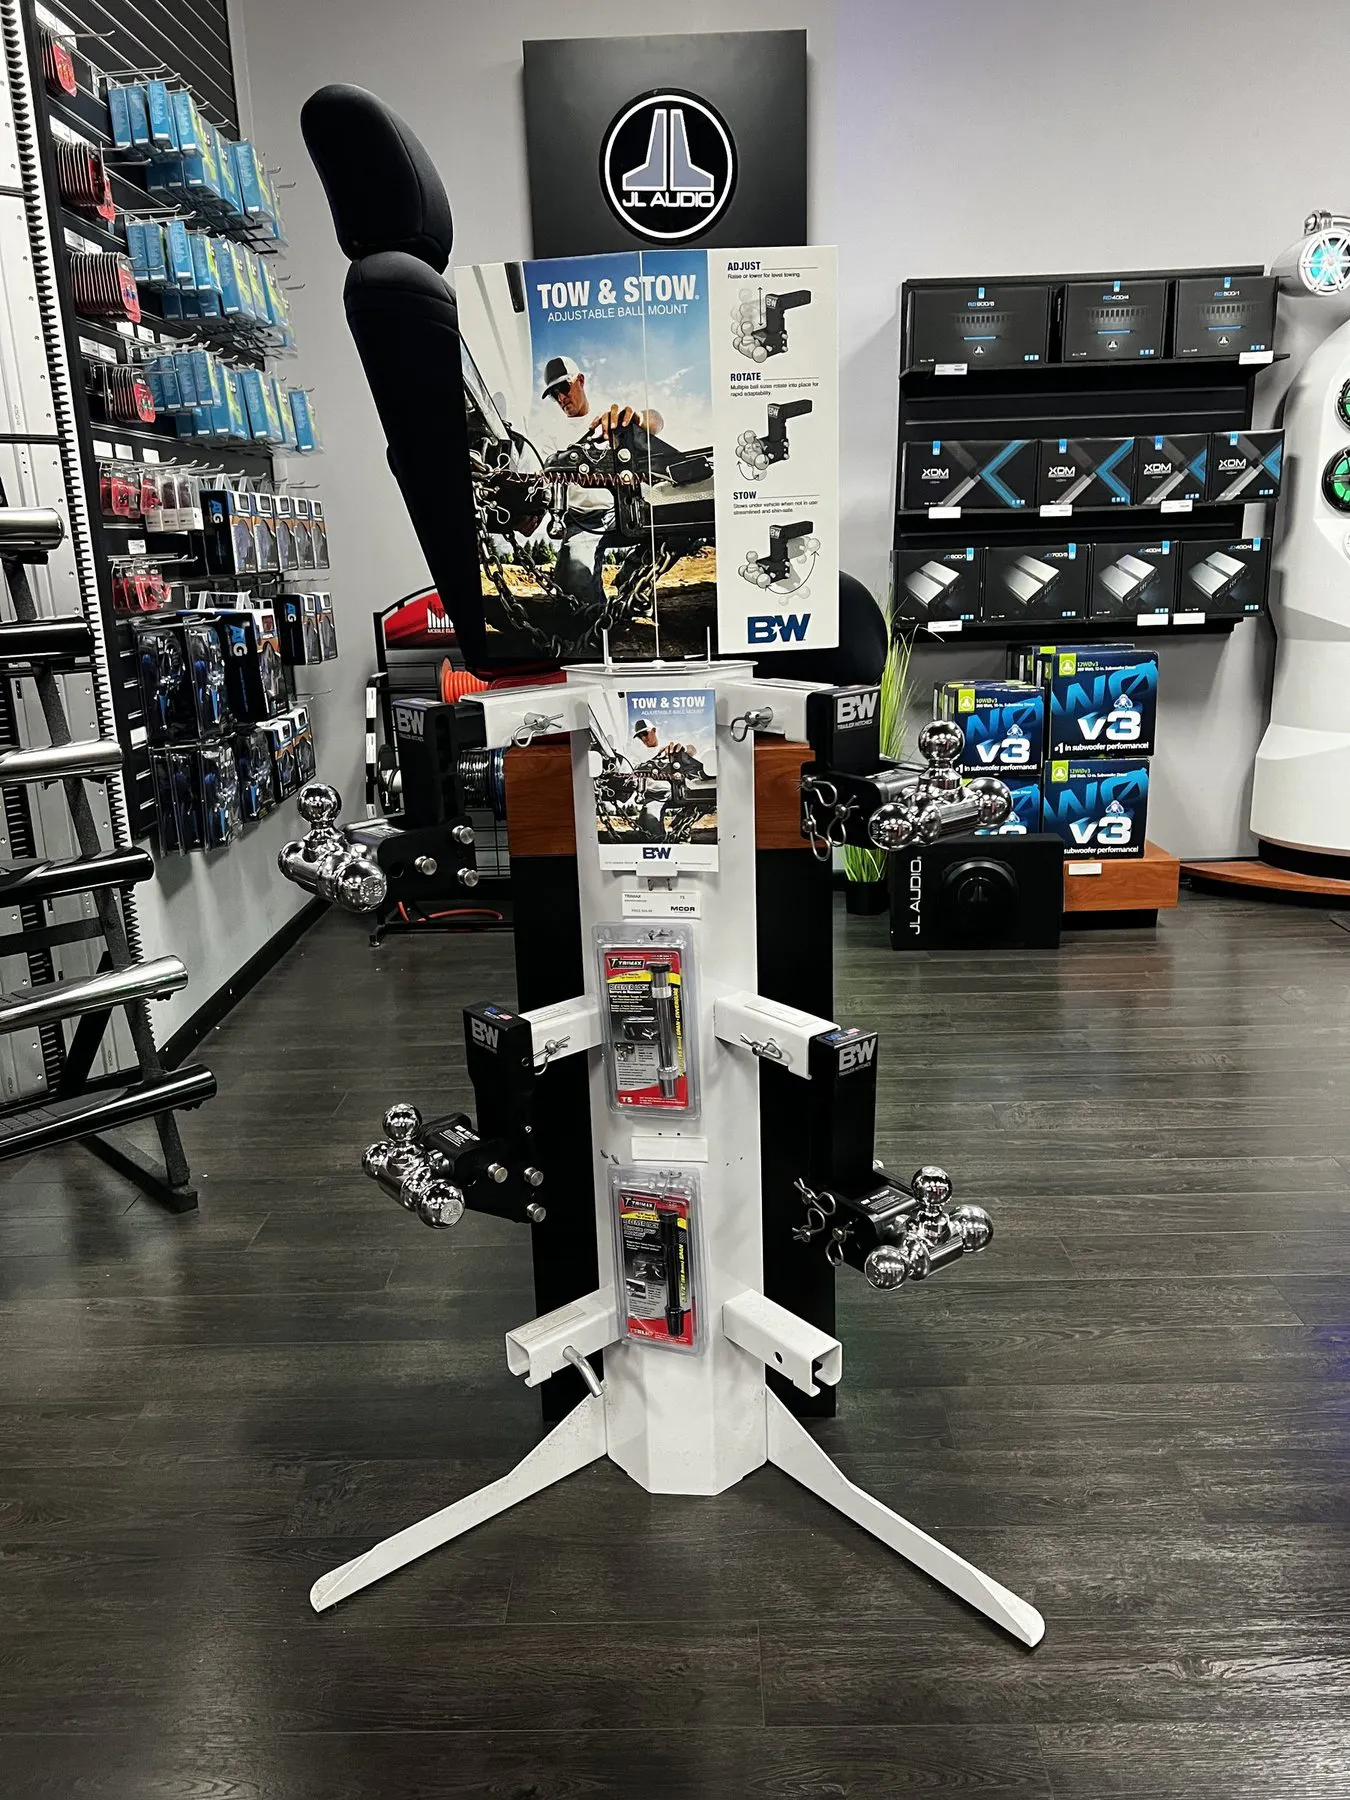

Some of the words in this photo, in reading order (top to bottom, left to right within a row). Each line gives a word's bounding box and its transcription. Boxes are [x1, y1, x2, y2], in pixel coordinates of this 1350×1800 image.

[622, 191, 647, 207] JL
[649, 191, 715, 208] AUDIO
[727, 261, 761, 271] ADJUST
[536, 280, 591, 310] TOW
[598, 278, 617, 305] &
[623, 274, 697, 303] STOW
[547, 307, 615, 322] ADJUSTABLE
[617, 306, 643, 317] BALL
[648, 303, 689, 316] MOUNT
[730, 372, 761, 382] ROTATE
[1144, 462, 1172, 473] XDM
[1218, 459, 1247, 469] XDM
[922, 468, 949, 478] XDM
[1048, 466, 1076, 477] XDM
[733, 491, 757, 500] STOW
[631, 697, 657, 709] TOW
[660, 697, 670, 708] &
[672, 695, 706, 708] STOW
[1077, 710, 1141, 741] v3
[975, 737, 1031, 764] v3
[1072, 743, 1106, 751] subwoofer
[1106, 741, 1149, 753] performance!
[971, 764, 1000, 772] subwoofer
[1000, 763, 1038, 772] performance!
[1069, 816, 1132, 844] v3
[1064, 846, 1097, 854] subwoofer
[1097, 845, 1139, 855] performance!
[909, 857, 922, 913] AUDIO
[909, 915, 921, 935] JL
